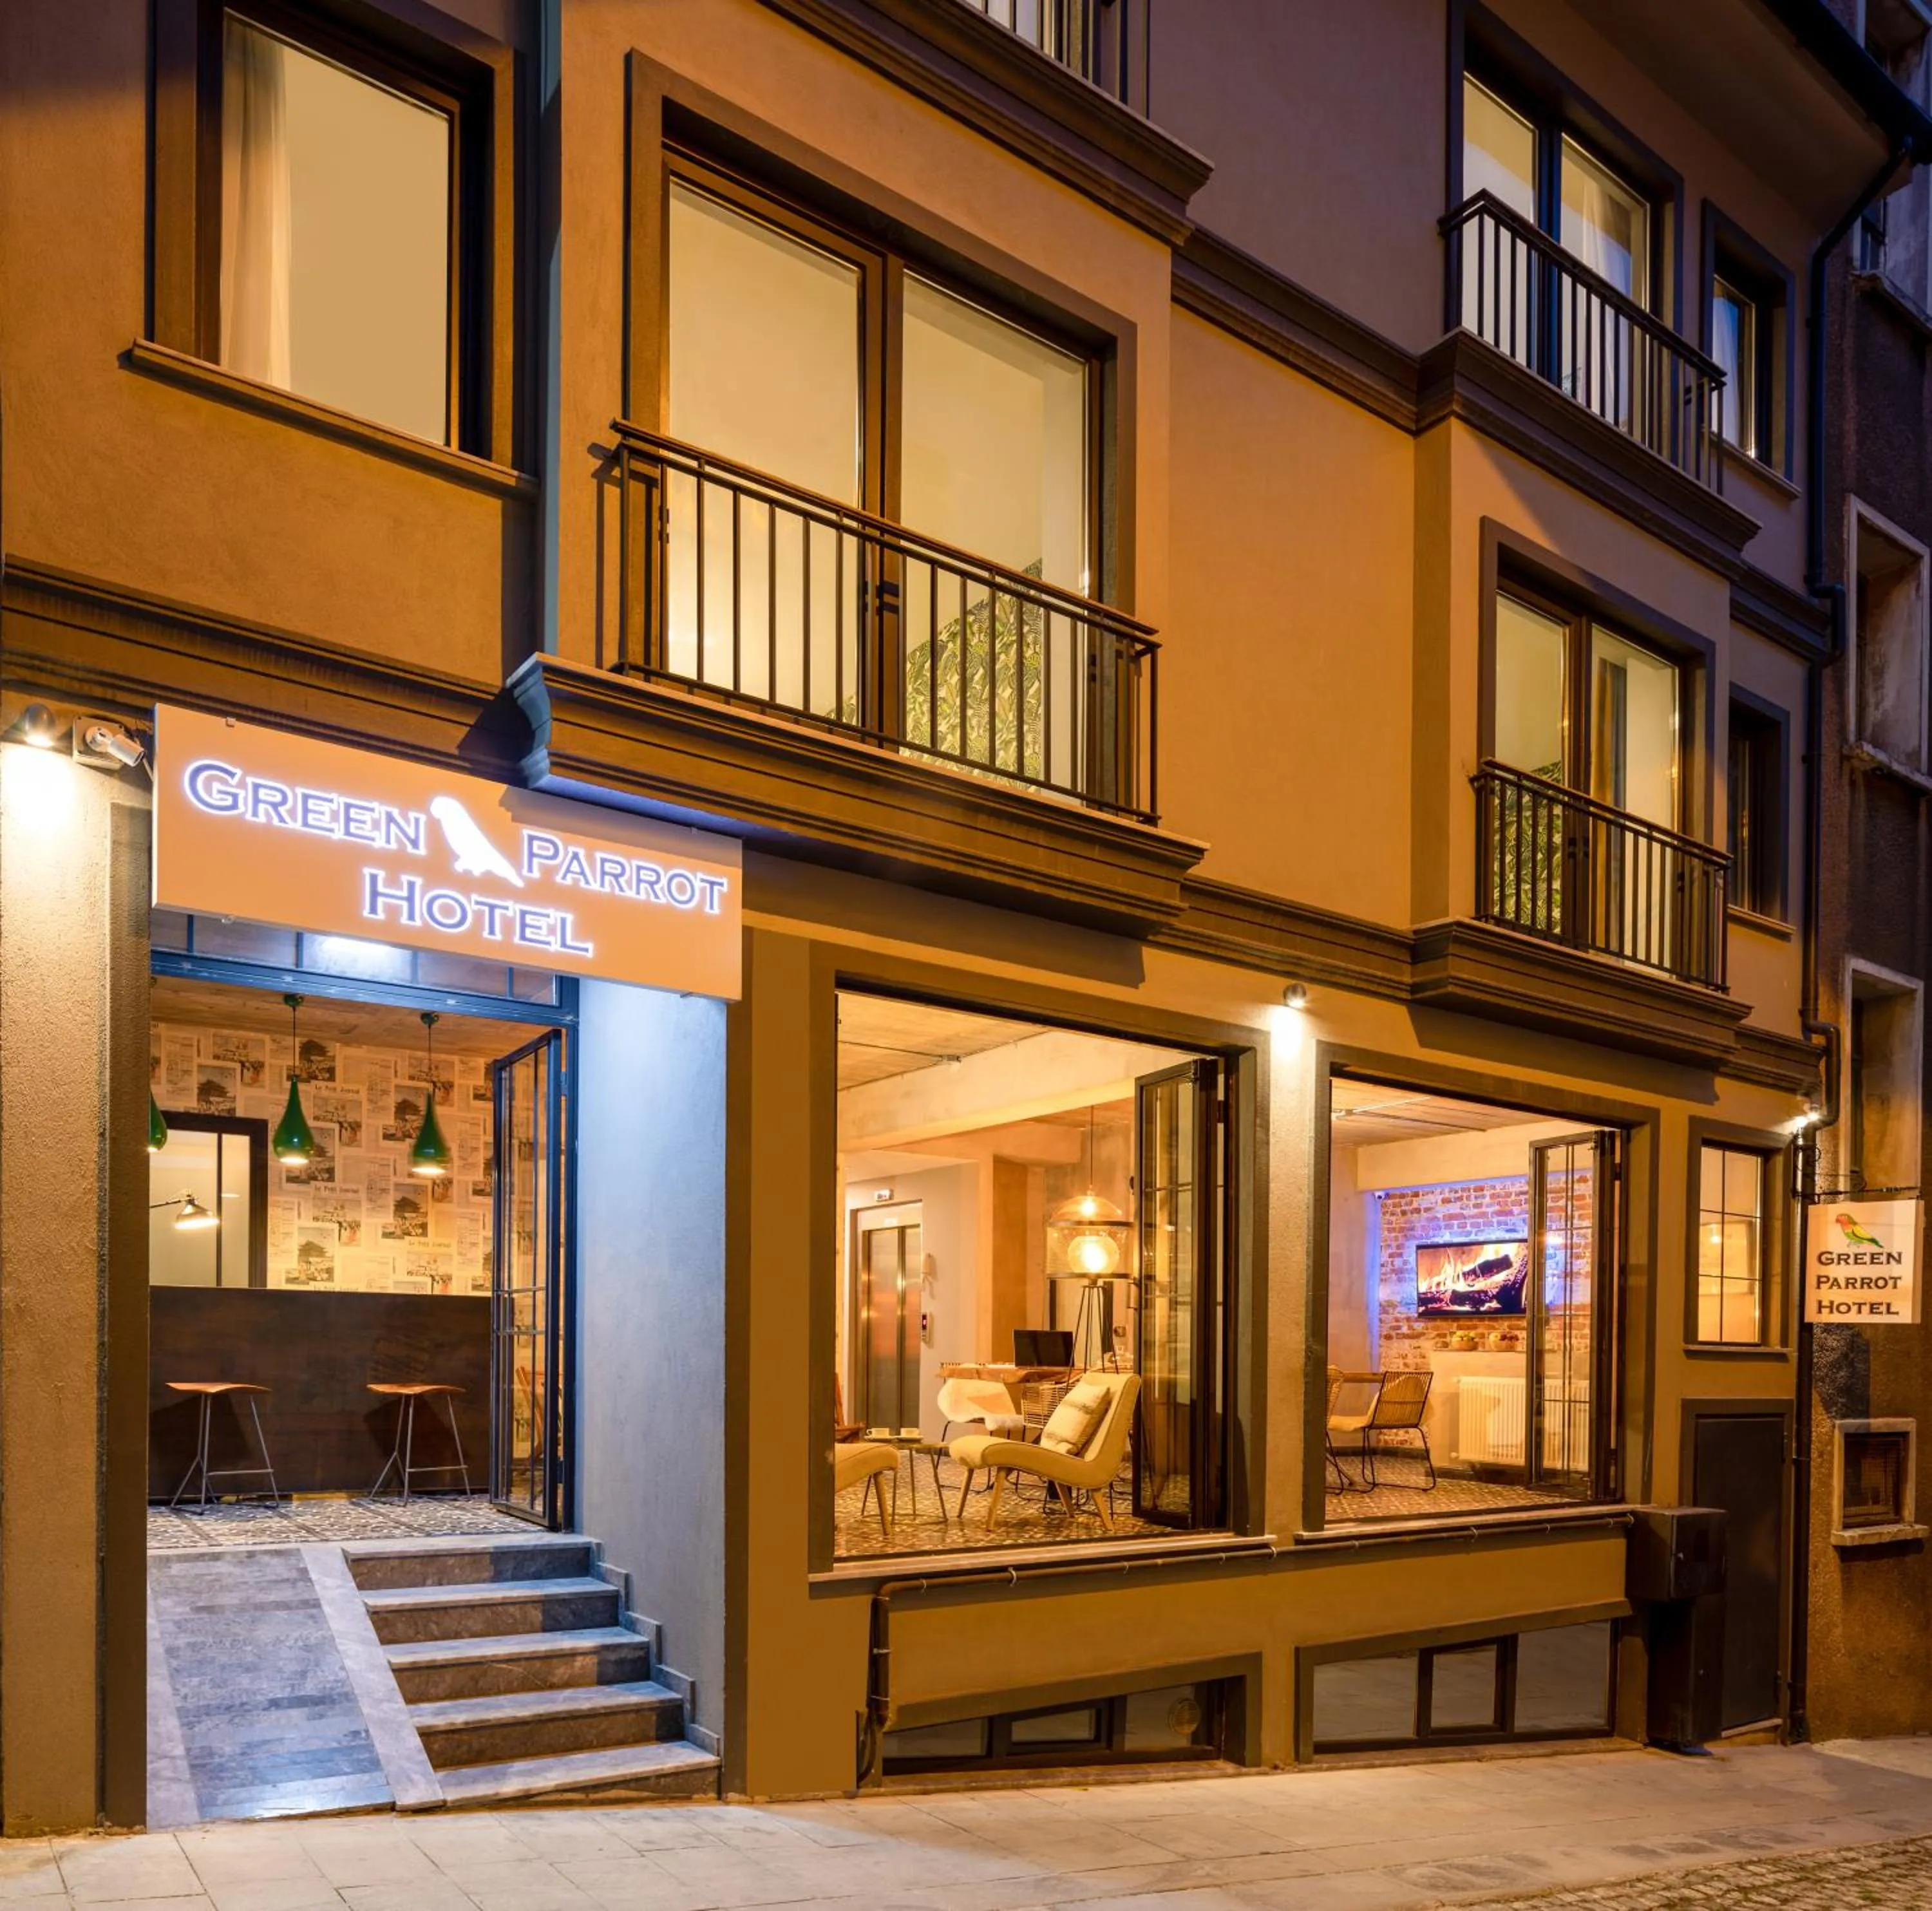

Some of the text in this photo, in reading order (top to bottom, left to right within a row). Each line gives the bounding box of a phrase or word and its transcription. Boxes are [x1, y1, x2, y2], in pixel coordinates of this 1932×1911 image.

[185, 760, 728, 913] GREEN PARROT
[363, 869, 594, 957] HOTEL
[1817, 1251, 1902, 1266] GREEN
[1816, 1274, 1902, 1290] PARROT
[1816, 1299, 1899, 1315] HOTEL
